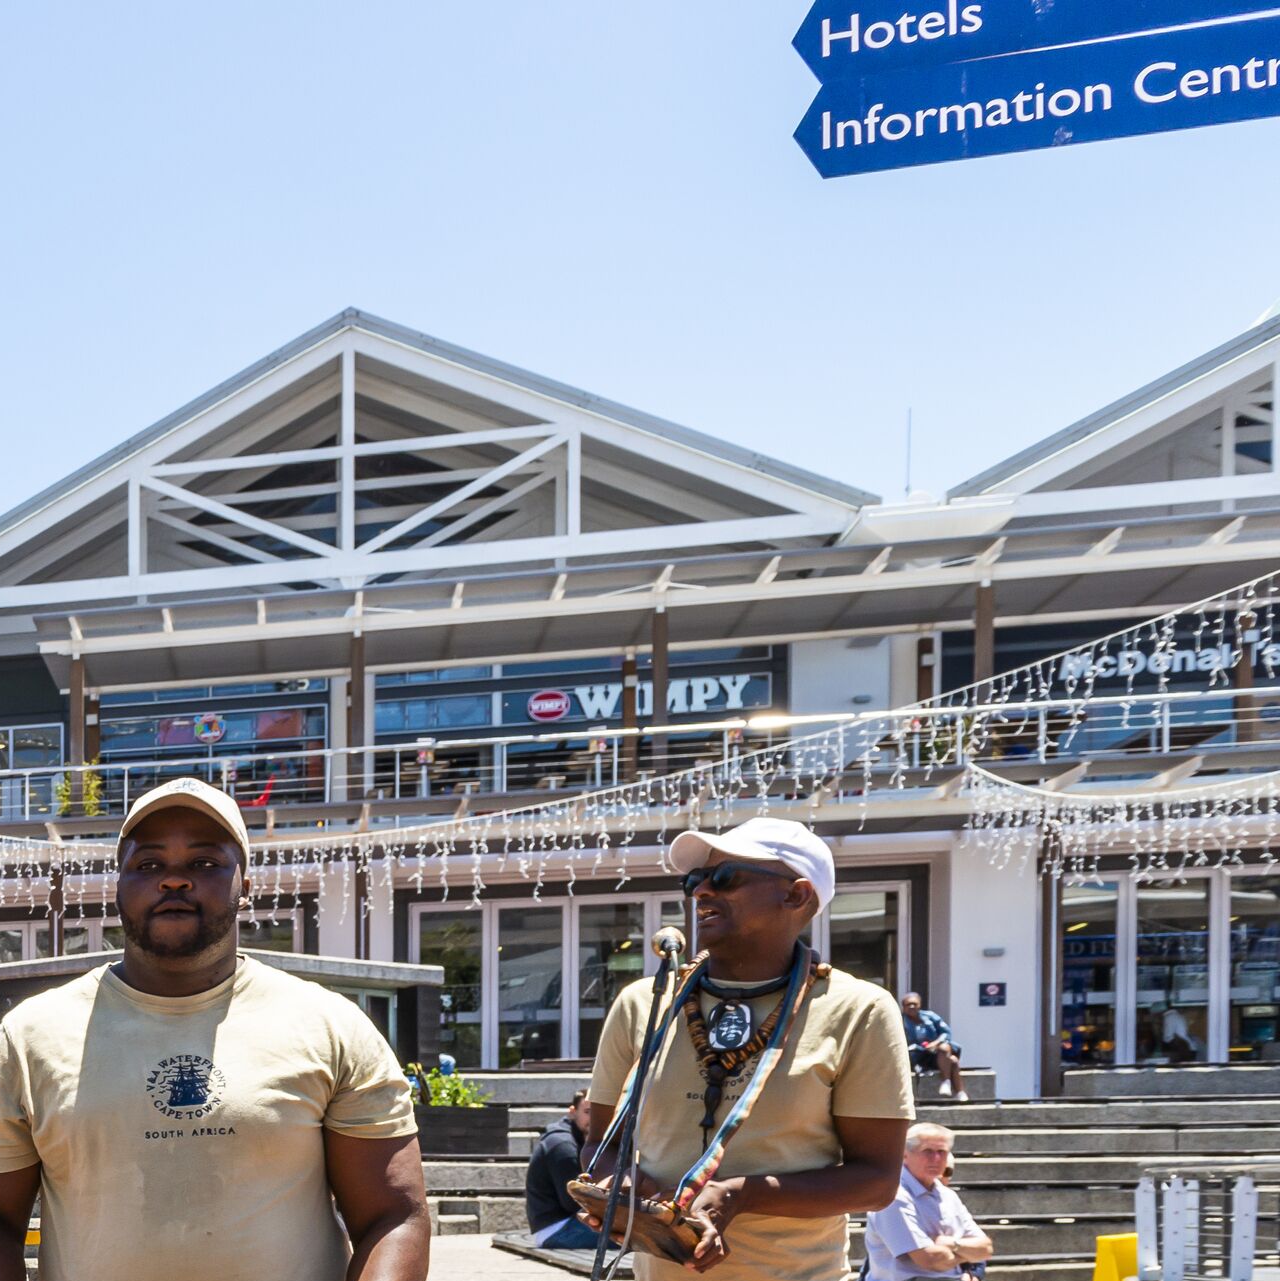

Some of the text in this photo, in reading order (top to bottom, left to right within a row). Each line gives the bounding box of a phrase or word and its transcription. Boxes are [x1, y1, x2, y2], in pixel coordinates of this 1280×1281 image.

[821, 0, 983, 58] Hotels
[821, 57, 1280, 150] Information Centr
[531, 699, 566, 712] WIMPY
[146, 1055, 226, 1092] V&A WATERFRONT
[154, 1097, 221, 1119] CAPE TOWN
[145, 1127, 236, 1139] SOUTH AFRICA
